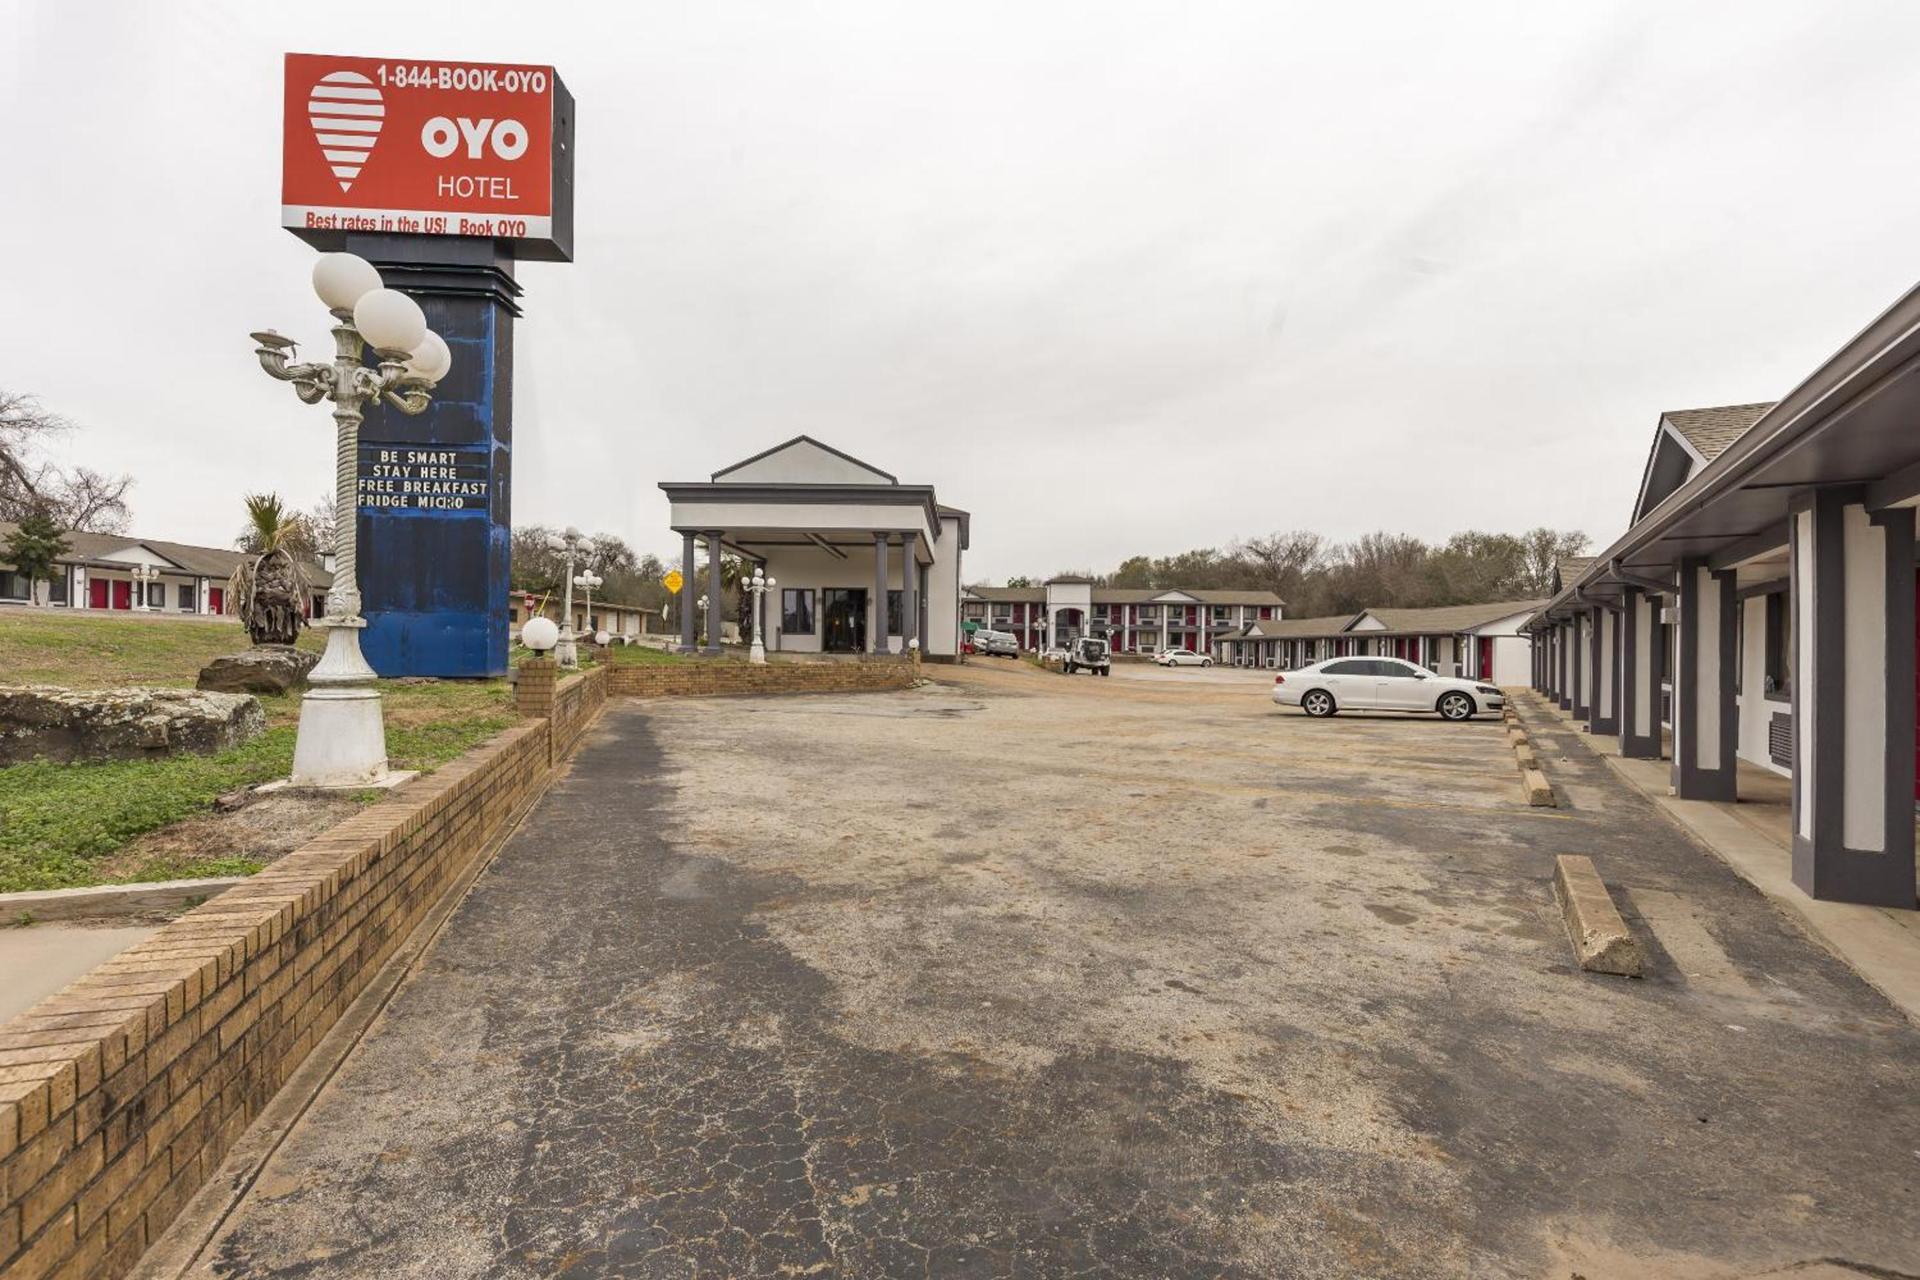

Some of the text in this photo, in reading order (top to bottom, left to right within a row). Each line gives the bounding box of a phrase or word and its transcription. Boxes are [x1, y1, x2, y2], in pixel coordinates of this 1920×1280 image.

[377, 64, 546, 93] 1-844-BOOK-OYO
[421, 116, 529, 161] OYO
[438, 175, 519, 199] HOTEL
[306, 212, 526, 237] Best rates in the US! Book OYO
[380, 451, 457, 464] BE SMART
[373, 465, 457, 479] STAY HERE
[358, 480, 488, 494] FREE BREAKFAST
[358, 495, 408, 507] FRIDGE
